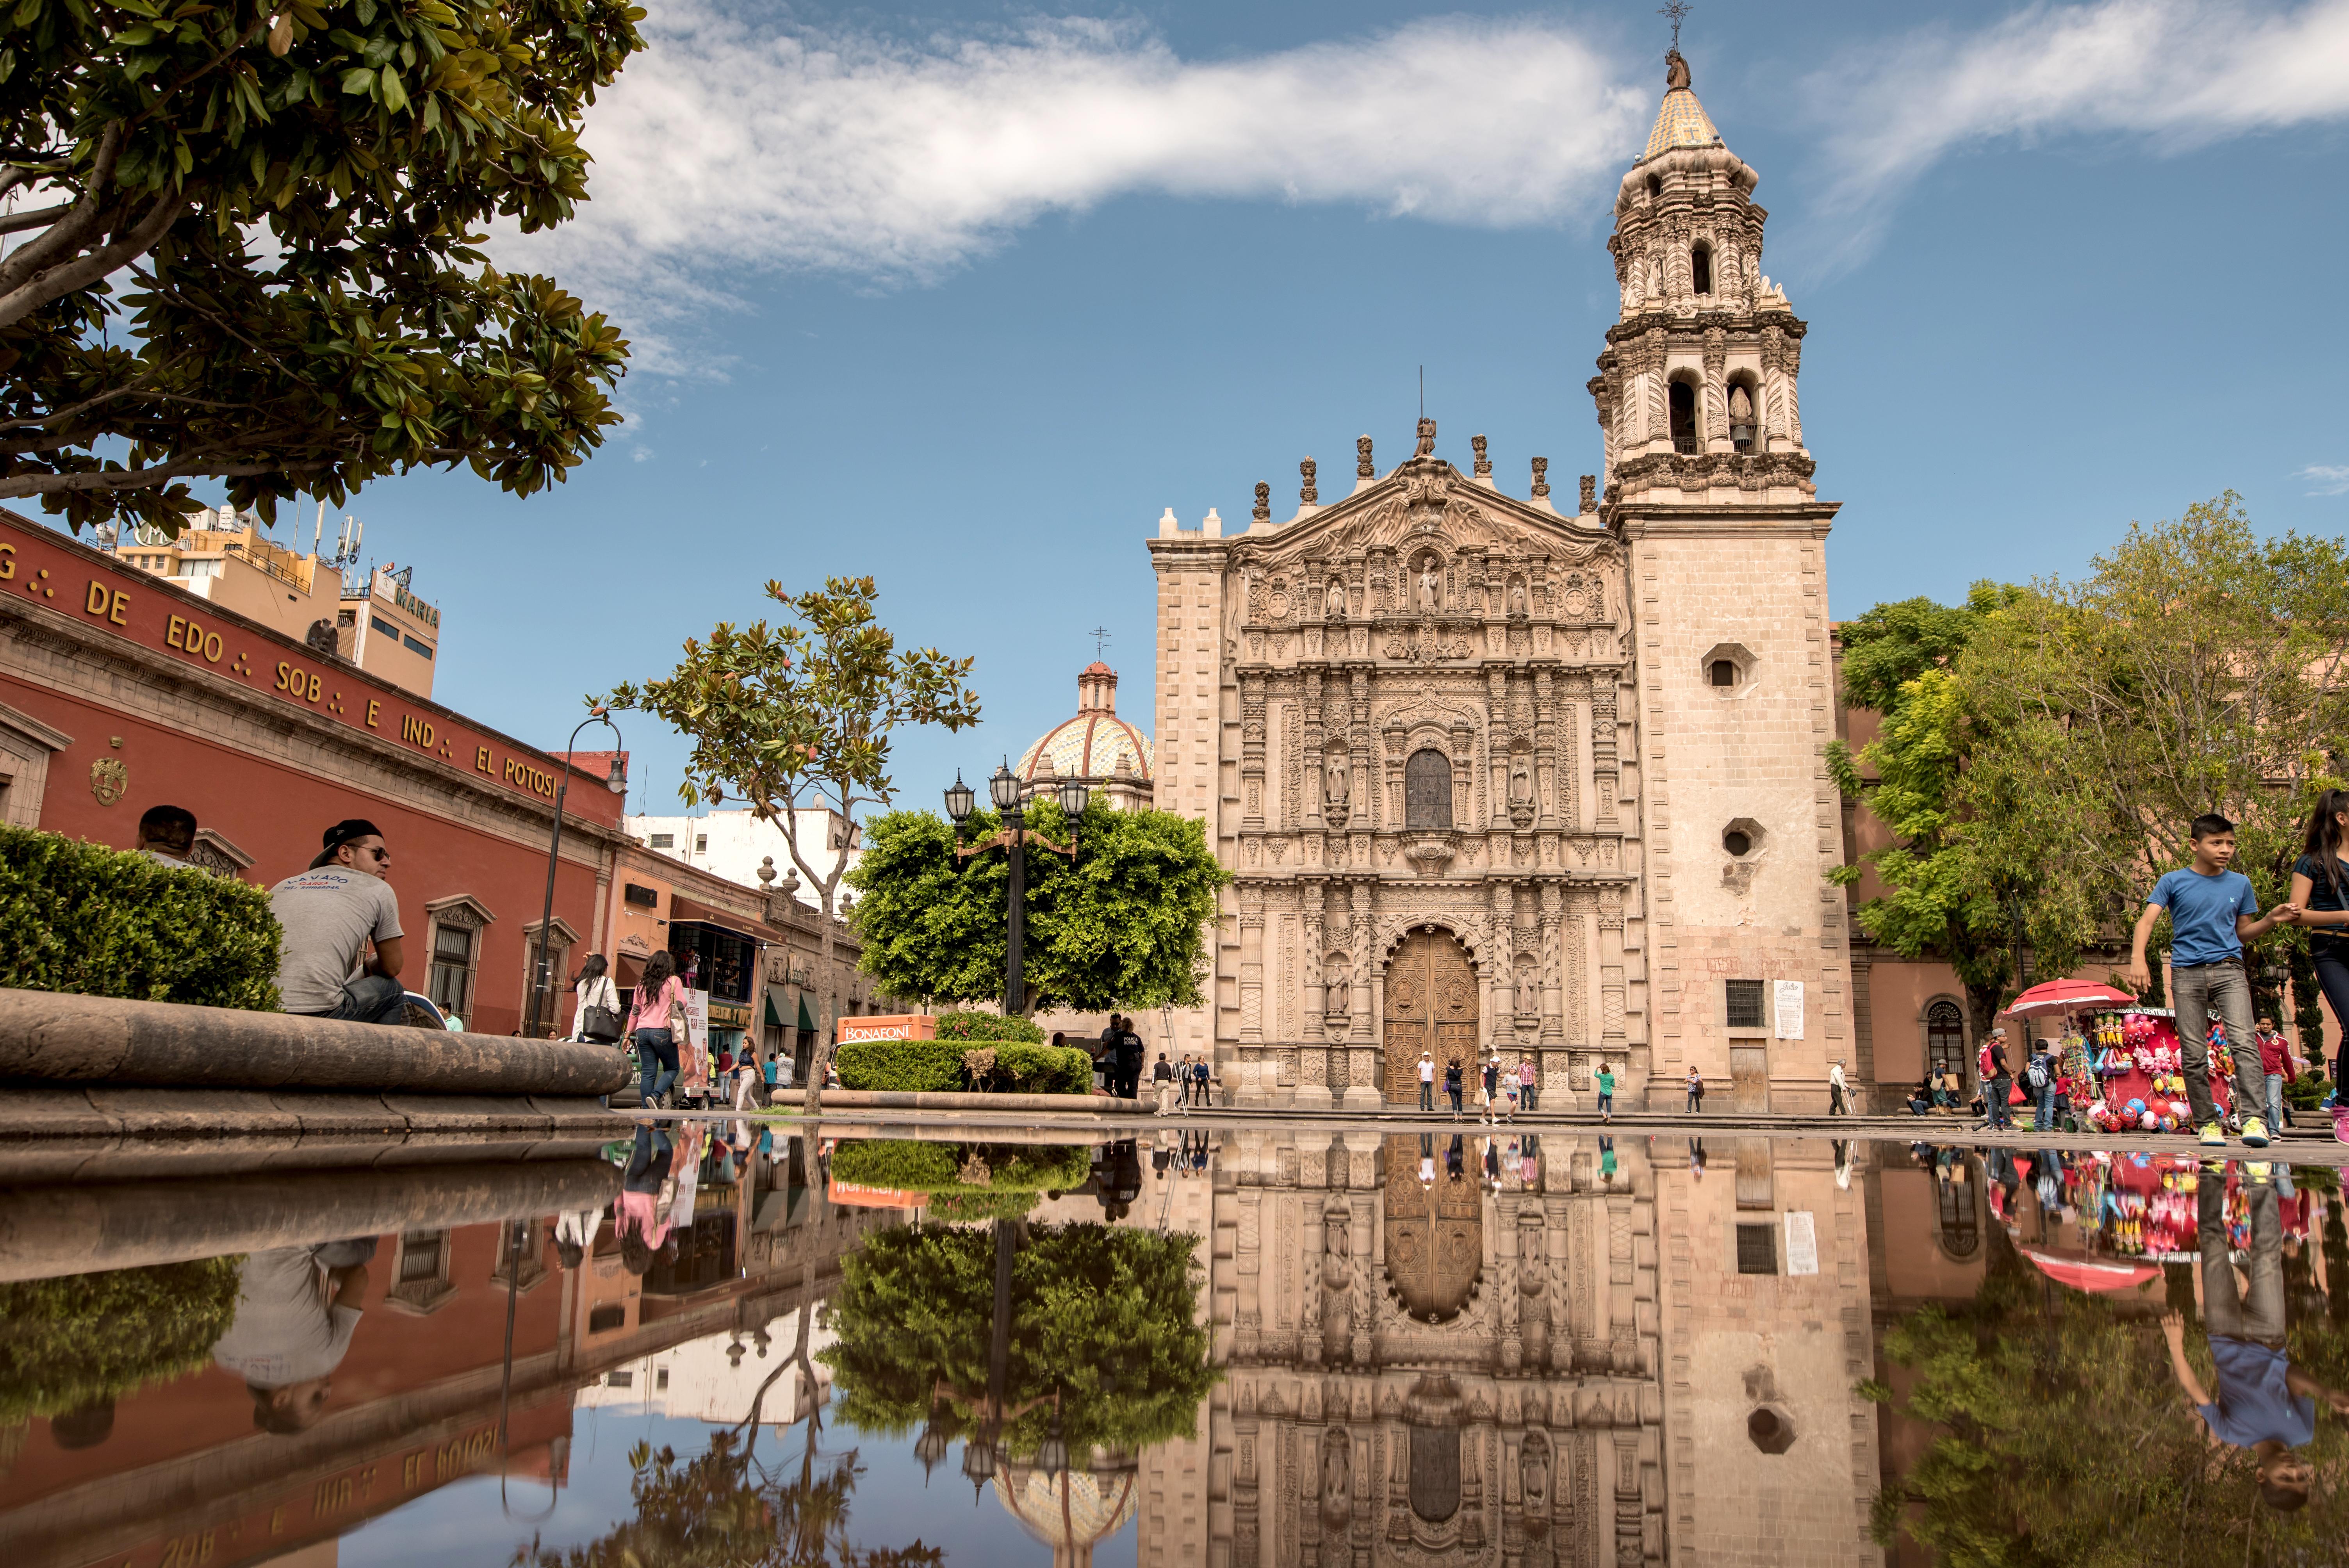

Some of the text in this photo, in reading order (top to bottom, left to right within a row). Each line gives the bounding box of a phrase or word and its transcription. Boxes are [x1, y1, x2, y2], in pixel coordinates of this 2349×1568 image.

[396, 587, 438, 629] MARIA
[85, 581, 130, 625] DE
[166, 614, 223, 662] EDO
[274, 661, 321, 702] SOB
[366, 699, 380, 727] E
[402, 715, 434, 748] IND
[476, 746, 495, 774] EL
[503, 758, 556, 798] POTOSI
[287, 875, 348, 884] LAVADO
[1779, 982, 1798, 993] Julio
[846, 1025, 911, 1040] BONAFONT
